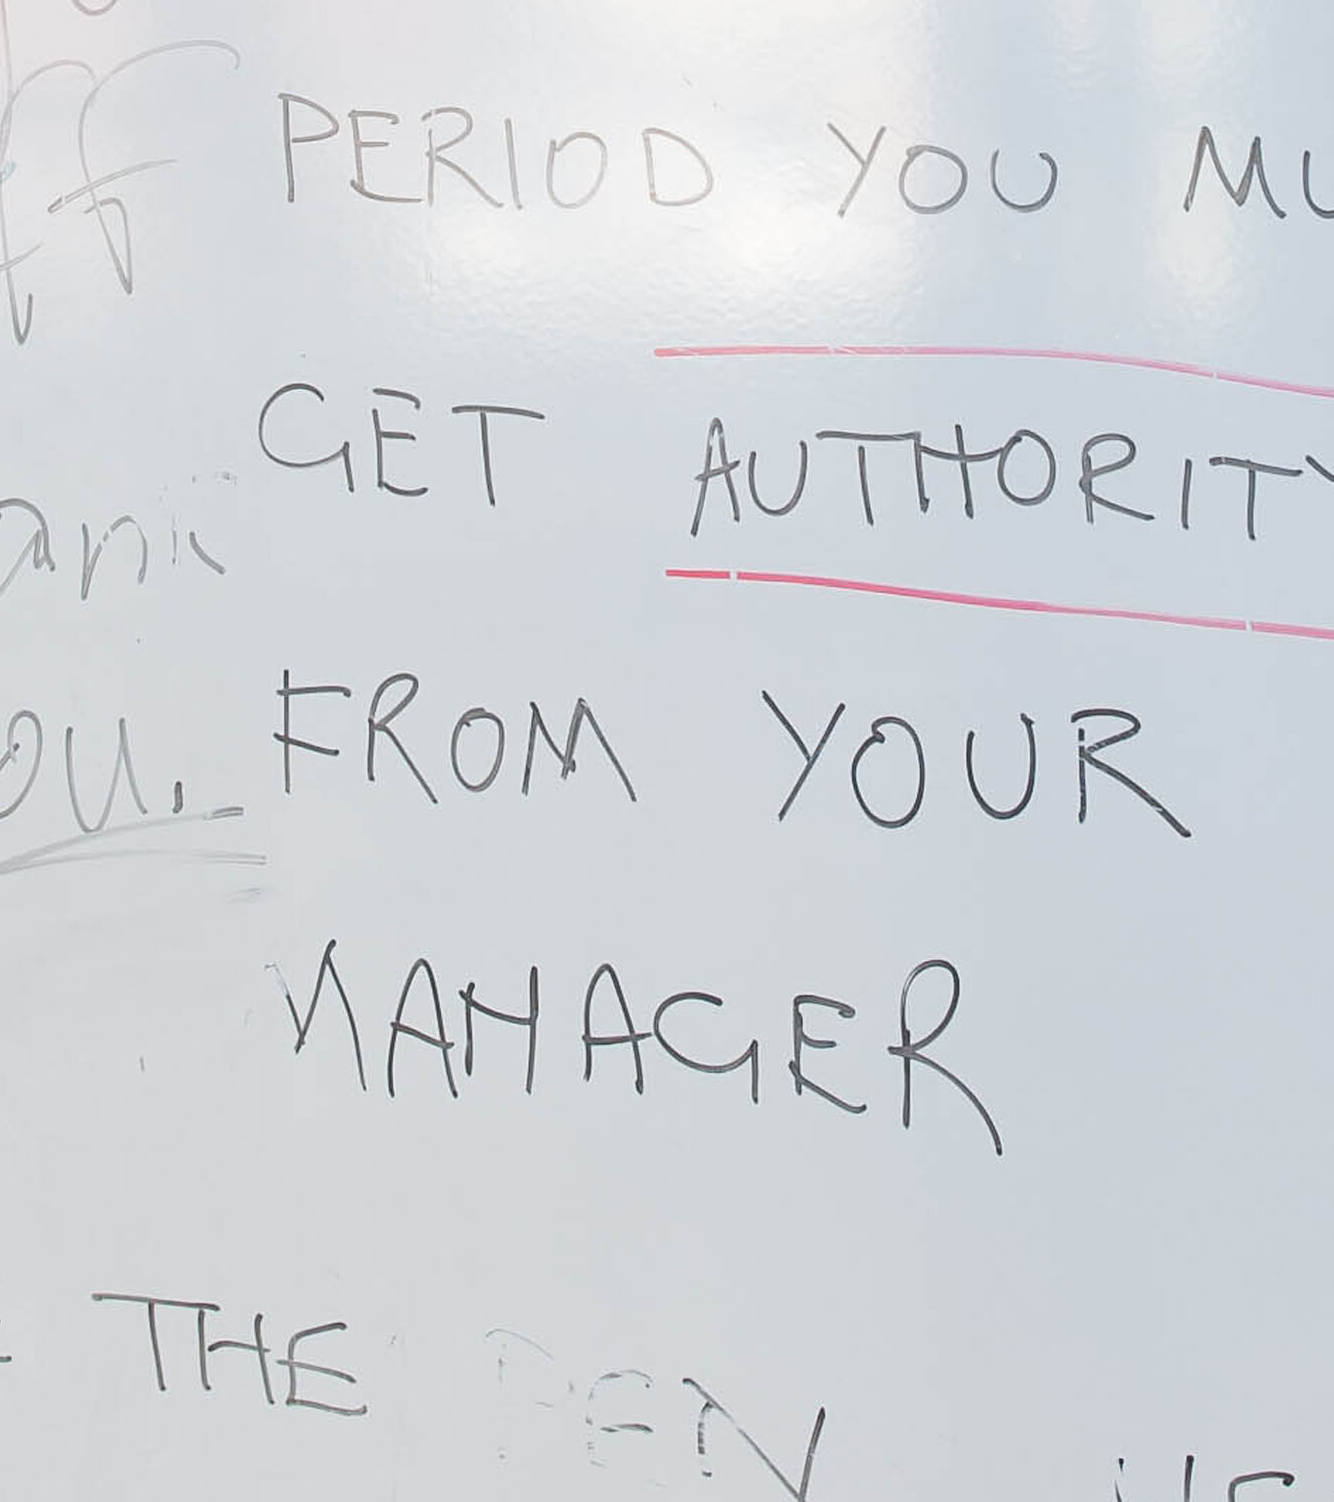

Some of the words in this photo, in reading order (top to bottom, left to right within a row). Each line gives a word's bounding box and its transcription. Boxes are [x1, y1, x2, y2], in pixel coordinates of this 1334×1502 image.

[276, 90, 716, 211] PERIOD
[827, 120, 1060, 220] YOU
[257, 381, 545, 507] GET
[272, 667, 637, 806] FROM
[761, 688, 1194, 839] YOUR
[264, 938, 1005, 1157] MANAGER
[91, 1290, 369, 1416] THE
